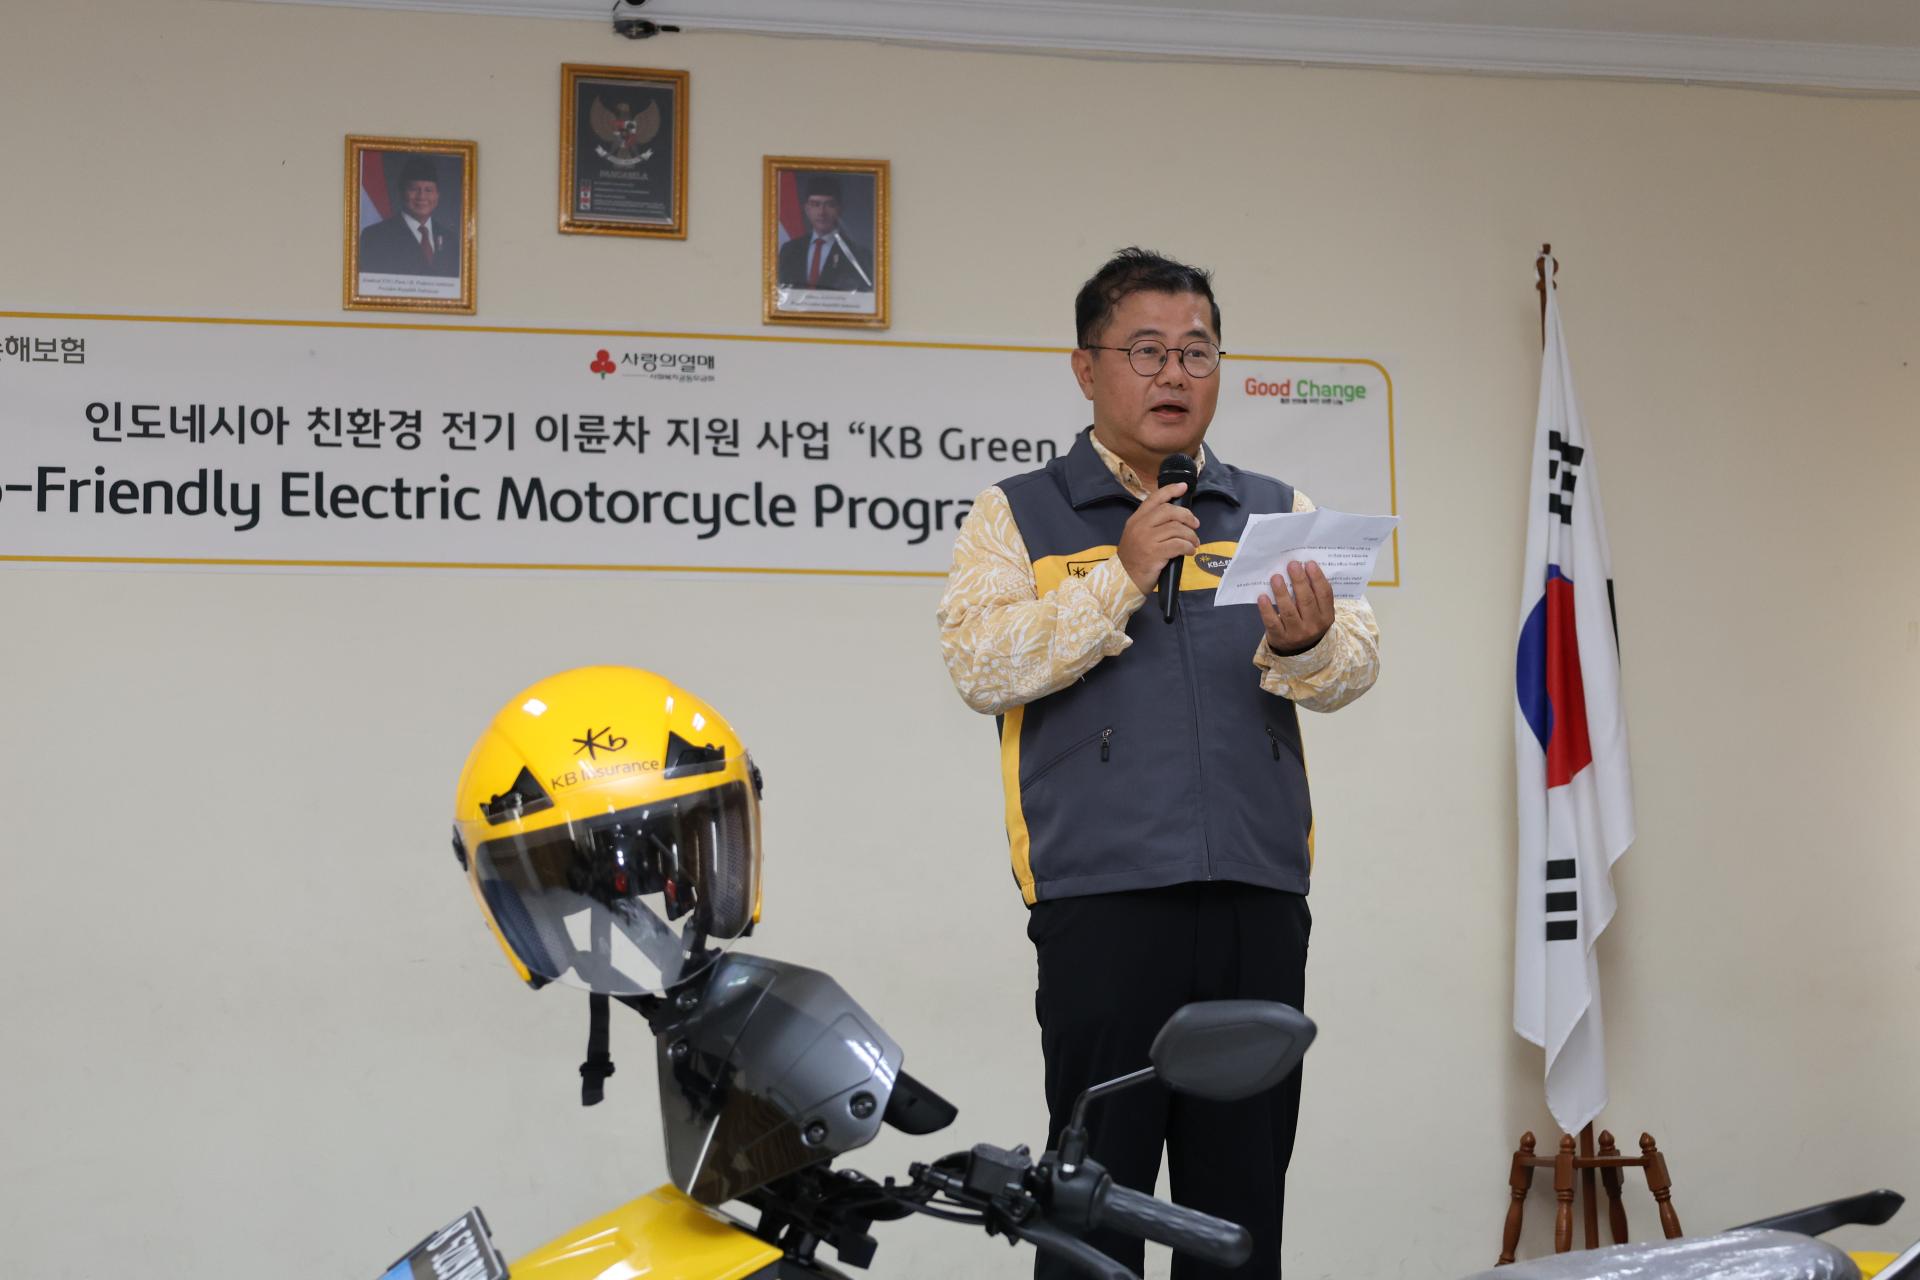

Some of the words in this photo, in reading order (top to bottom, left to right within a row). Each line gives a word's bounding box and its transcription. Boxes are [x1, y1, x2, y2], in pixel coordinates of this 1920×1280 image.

[0, 336, 85, 364] 해보험
[621, 353, 715, 373] 사랑의열매
[1245, 378, 1290, 397] Good
[1297, 379, 1367, 402] Change
[86, 402, 289, 445] 인도네시아
[308, 407, 422, 451] 친환경
[442, 412, 514, 450] 전기
[536, 414, 650, 454] 이륜차
[667, 418, 740, 458] 지원
[757, 421, 829, 461] 사업
[939, 428, 1056, 462] Green
[0, 466, 260, 532] -Friendly
[282, 472, 481, 521] Electric
[497, 477, 797, 540] Motorcycle
[551, 773, 578, 790] KB
